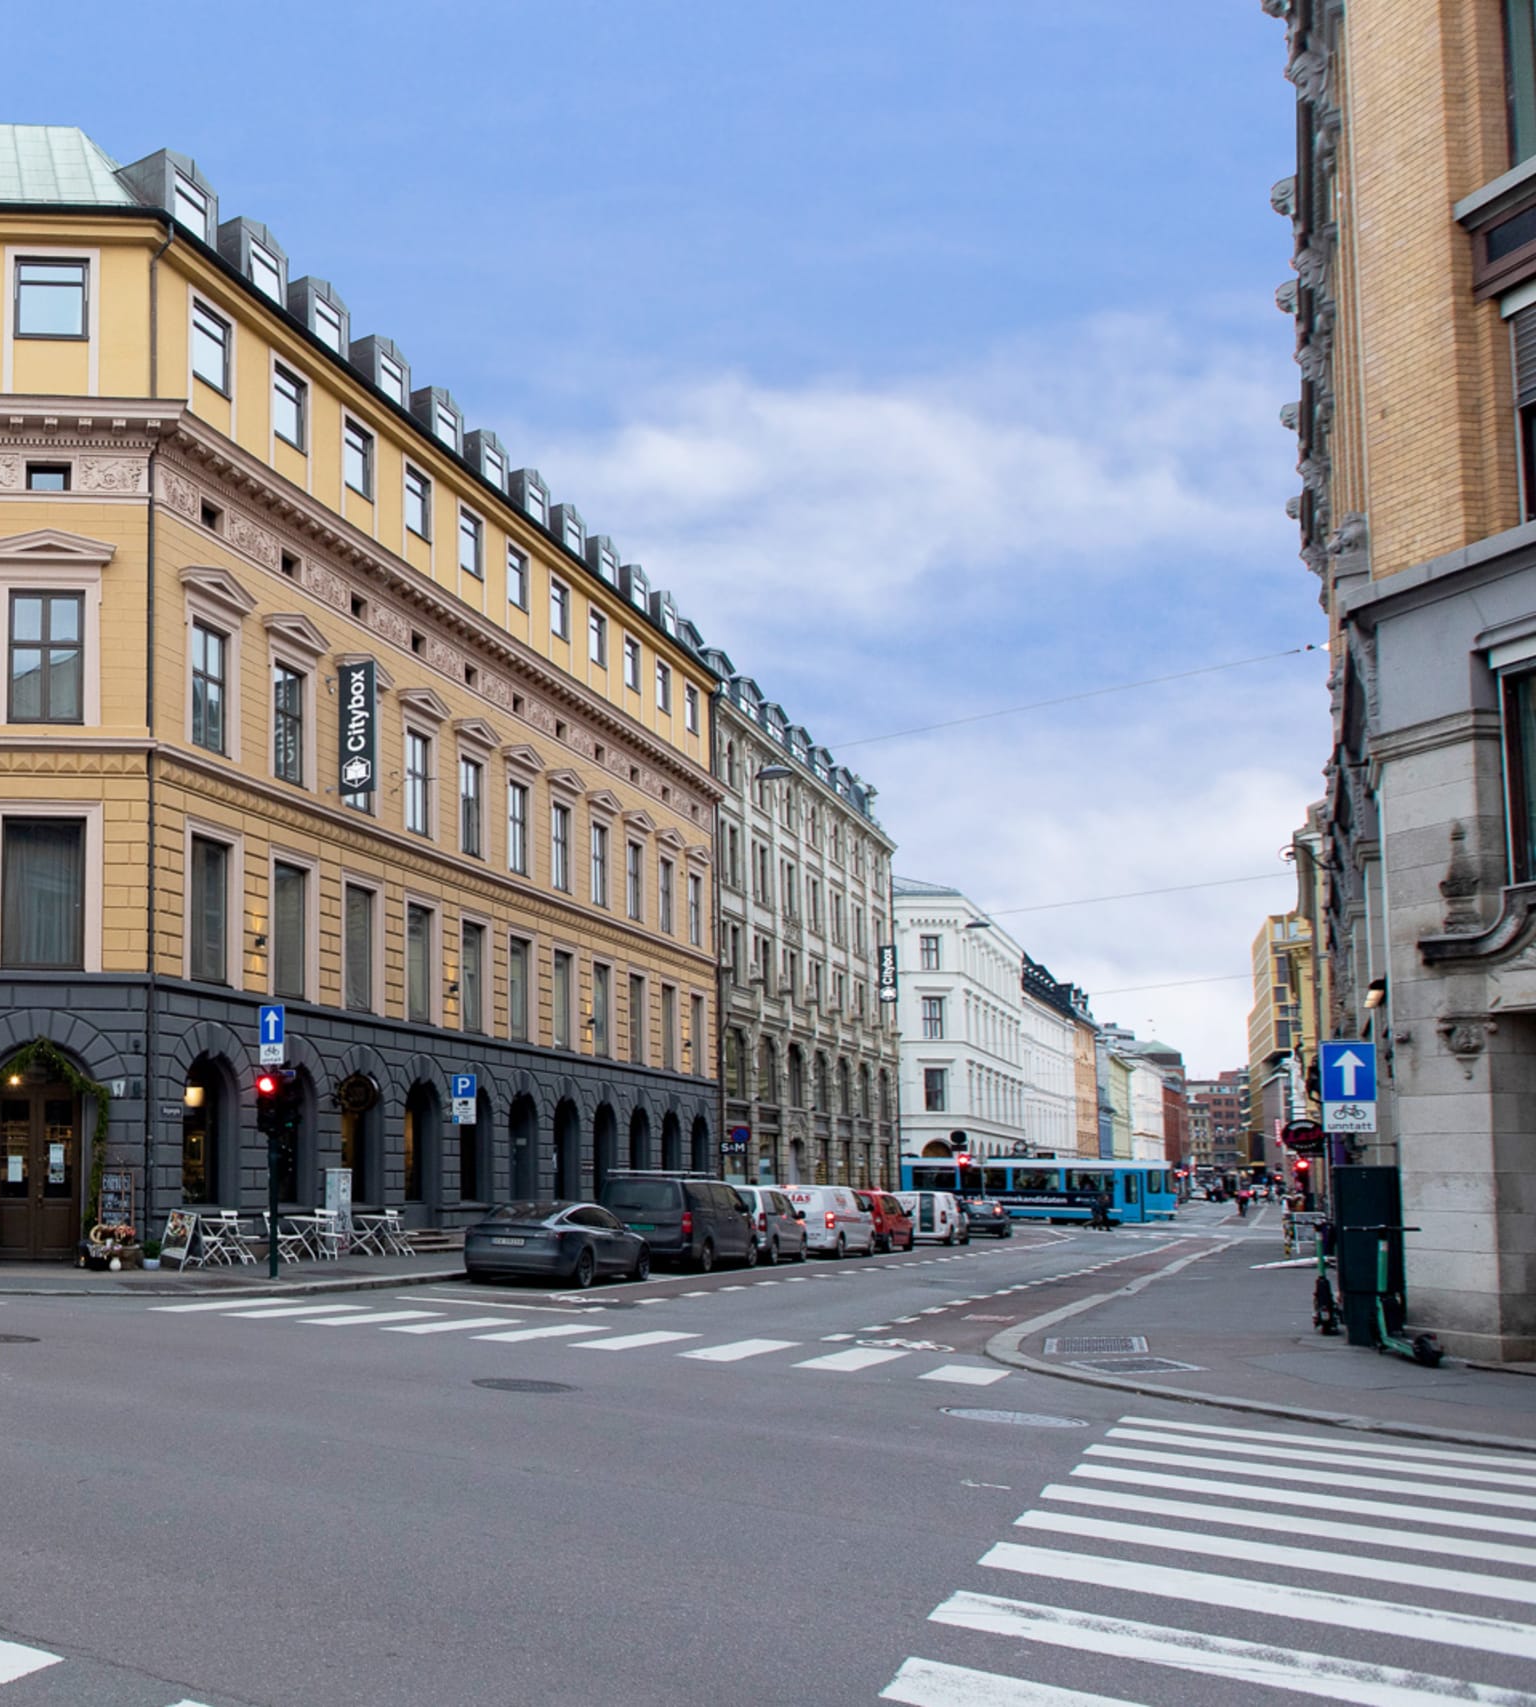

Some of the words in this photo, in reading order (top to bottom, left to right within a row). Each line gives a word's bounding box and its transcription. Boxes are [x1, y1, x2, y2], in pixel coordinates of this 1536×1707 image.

[347, 669, 369, 752] Citybox
[881, 948, 895, 985] Citybox
[458, 1077, 470, 1095] P
[1327, 1122, 1373, 1130] unntatt
